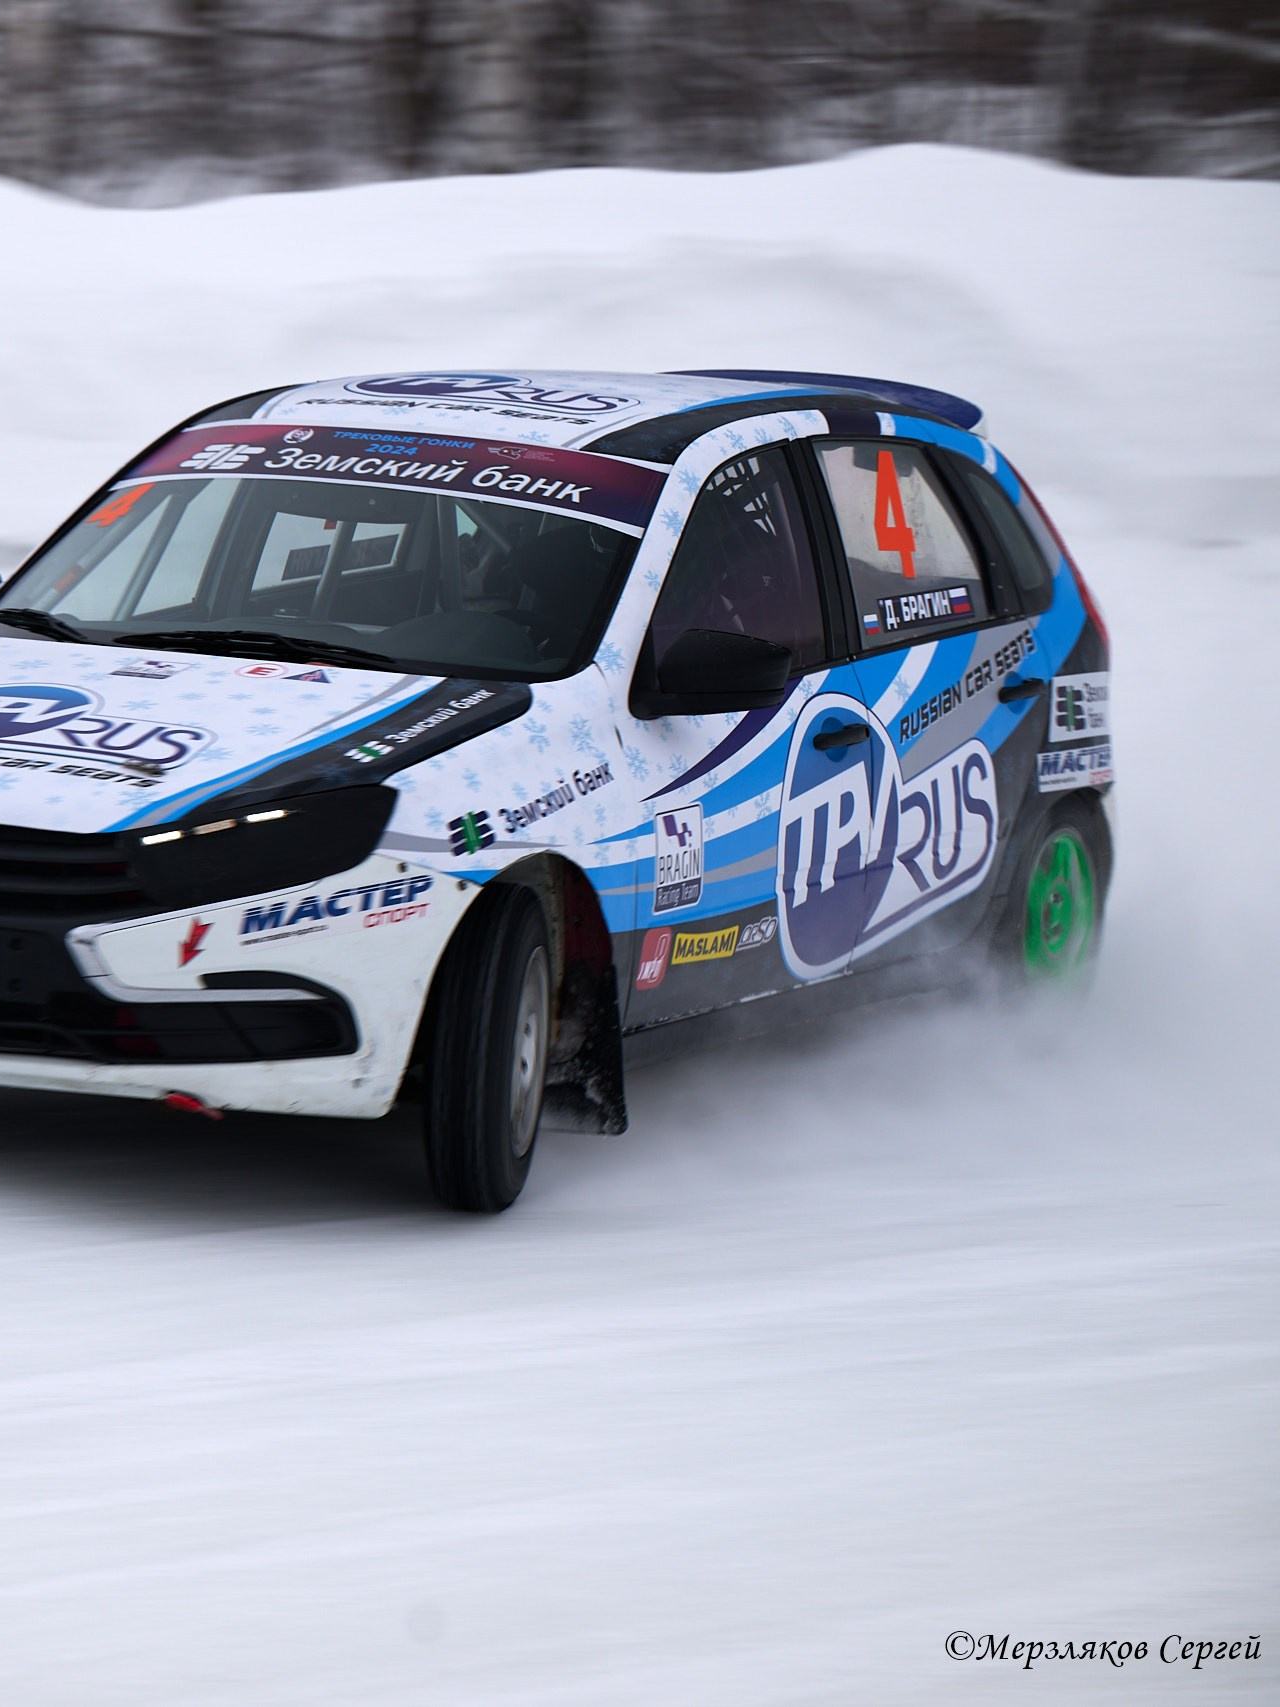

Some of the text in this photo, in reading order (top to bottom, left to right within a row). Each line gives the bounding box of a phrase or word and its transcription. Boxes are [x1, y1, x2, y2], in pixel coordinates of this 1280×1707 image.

[331, 429, 476, 449] ТРЕКОВЫЕ ГОНКИ
[364, 443, 418, 456] 2024
[263, 446, 593, 503] Земский банк
[85, 482, 157, 528] 4
[873, 450, 916, 579] 4
[884, 590, 952, 630] Д. БРАГИН
[245, 666, 277, 676] E
[900, 628, 1036, 744] RUSSIAN CAR SEATS
[384, 688, 496, 744] Земский банк
[48, 764, 164, 788] SEATS
[497, 762, 616, 834] Земский банк
[658, 844, 701, 886] BRAGIN
[238, 874, 435, 936] МАСТЕР
[363, 903, 431, 929] СПОРТ
[674, 931, 737, 959] MASLAMI
